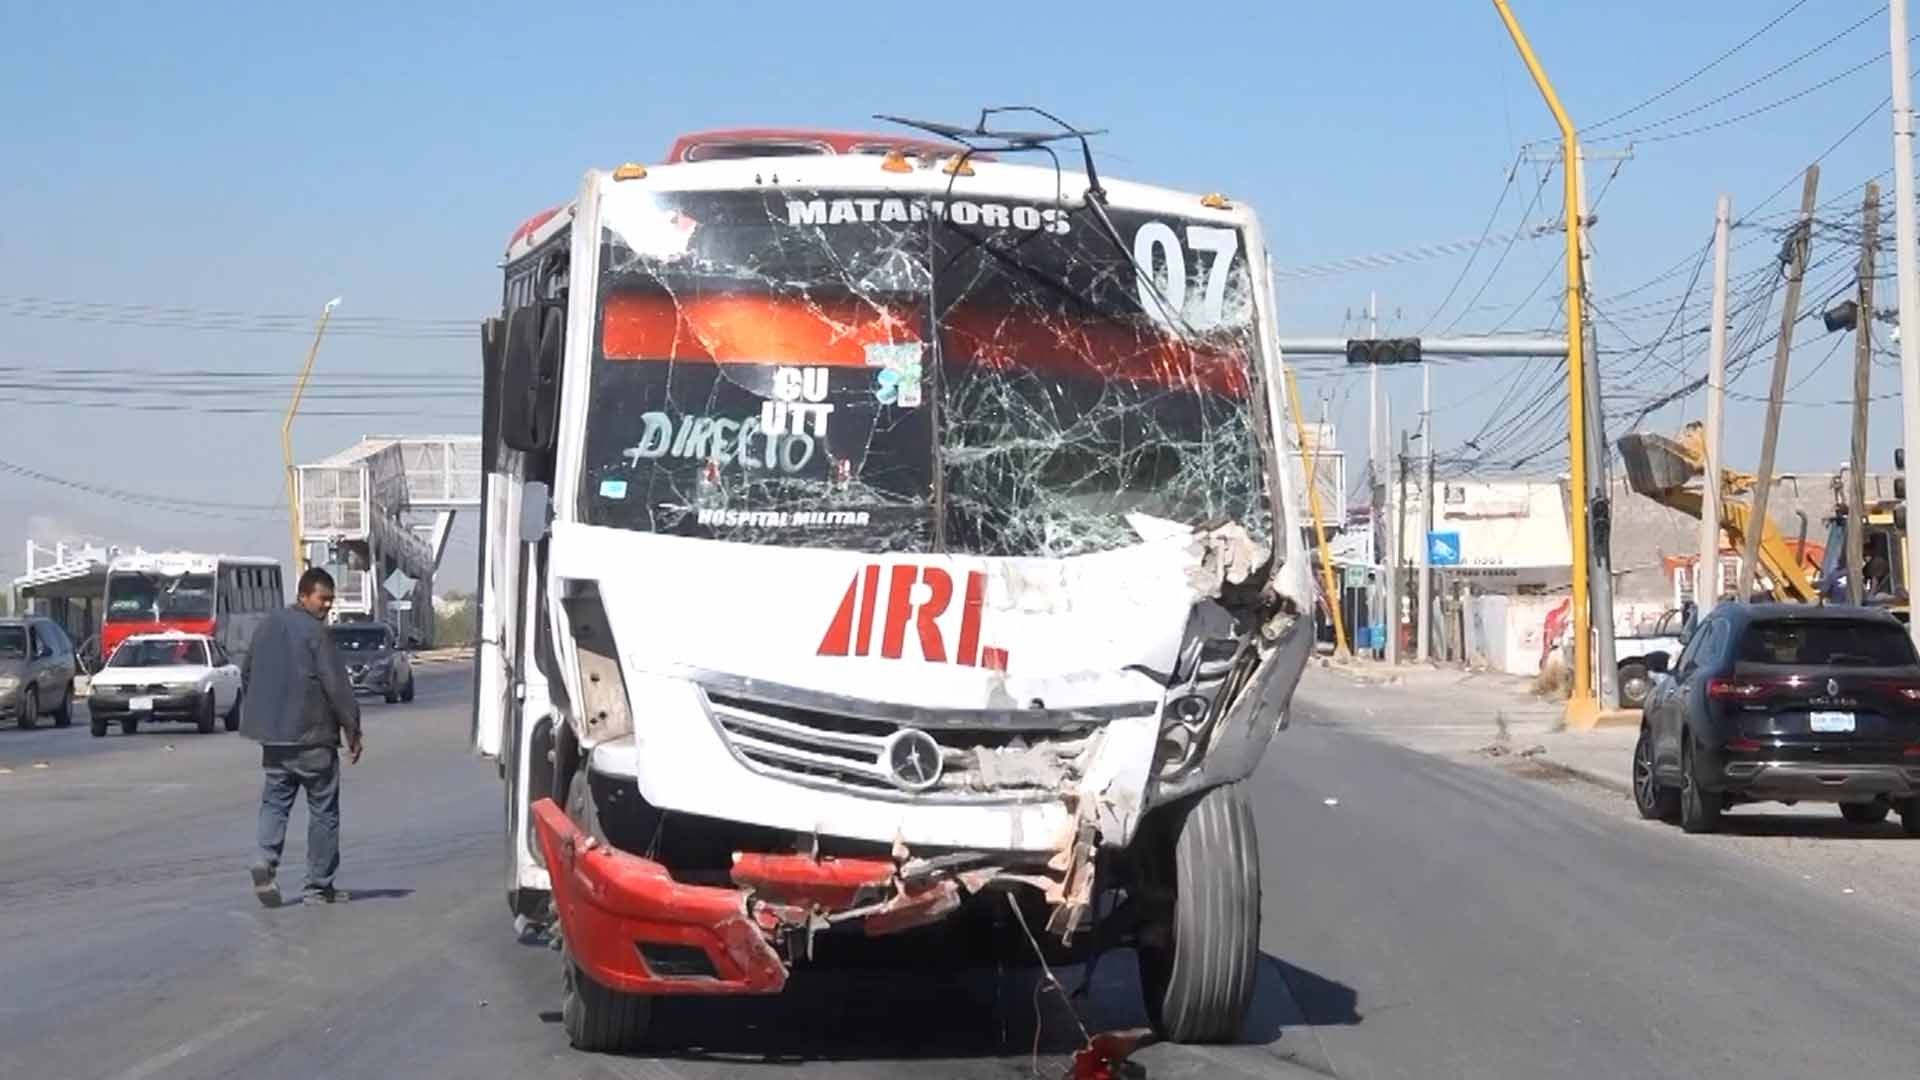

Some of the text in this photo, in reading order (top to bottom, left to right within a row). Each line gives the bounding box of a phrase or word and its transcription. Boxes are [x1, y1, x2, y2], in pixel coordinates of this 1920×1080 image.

[784, 198, 1071, 235] MATAMOROS
[1134, 221, 1239, 327] 07
[760, 400, 835, 437] UTT
[698, 507, 870, 527] HOSPITAL MILITAR
